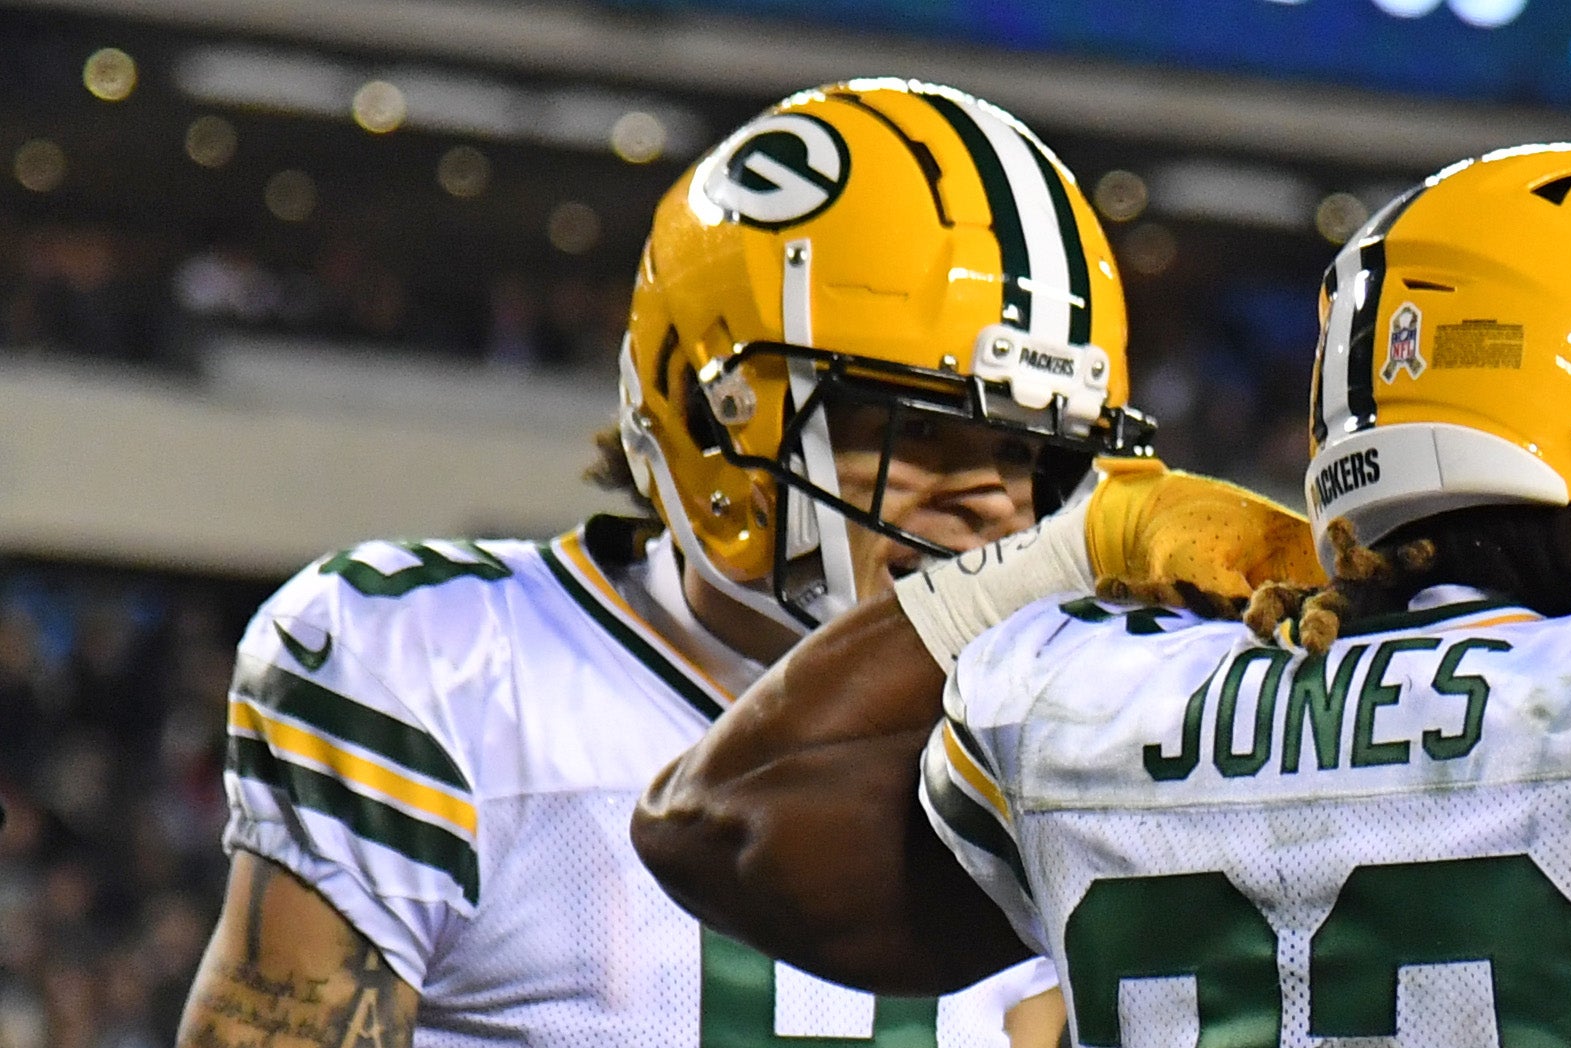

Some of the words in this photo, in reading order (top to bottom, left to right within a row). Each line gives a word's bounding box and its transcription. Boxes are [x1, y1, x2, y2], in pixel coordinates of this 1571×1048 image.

[689, 111, 845, 227] G
[1019, 347, 1075, 378] PACKERS
[1143, 636, 1512, 782] JONES
